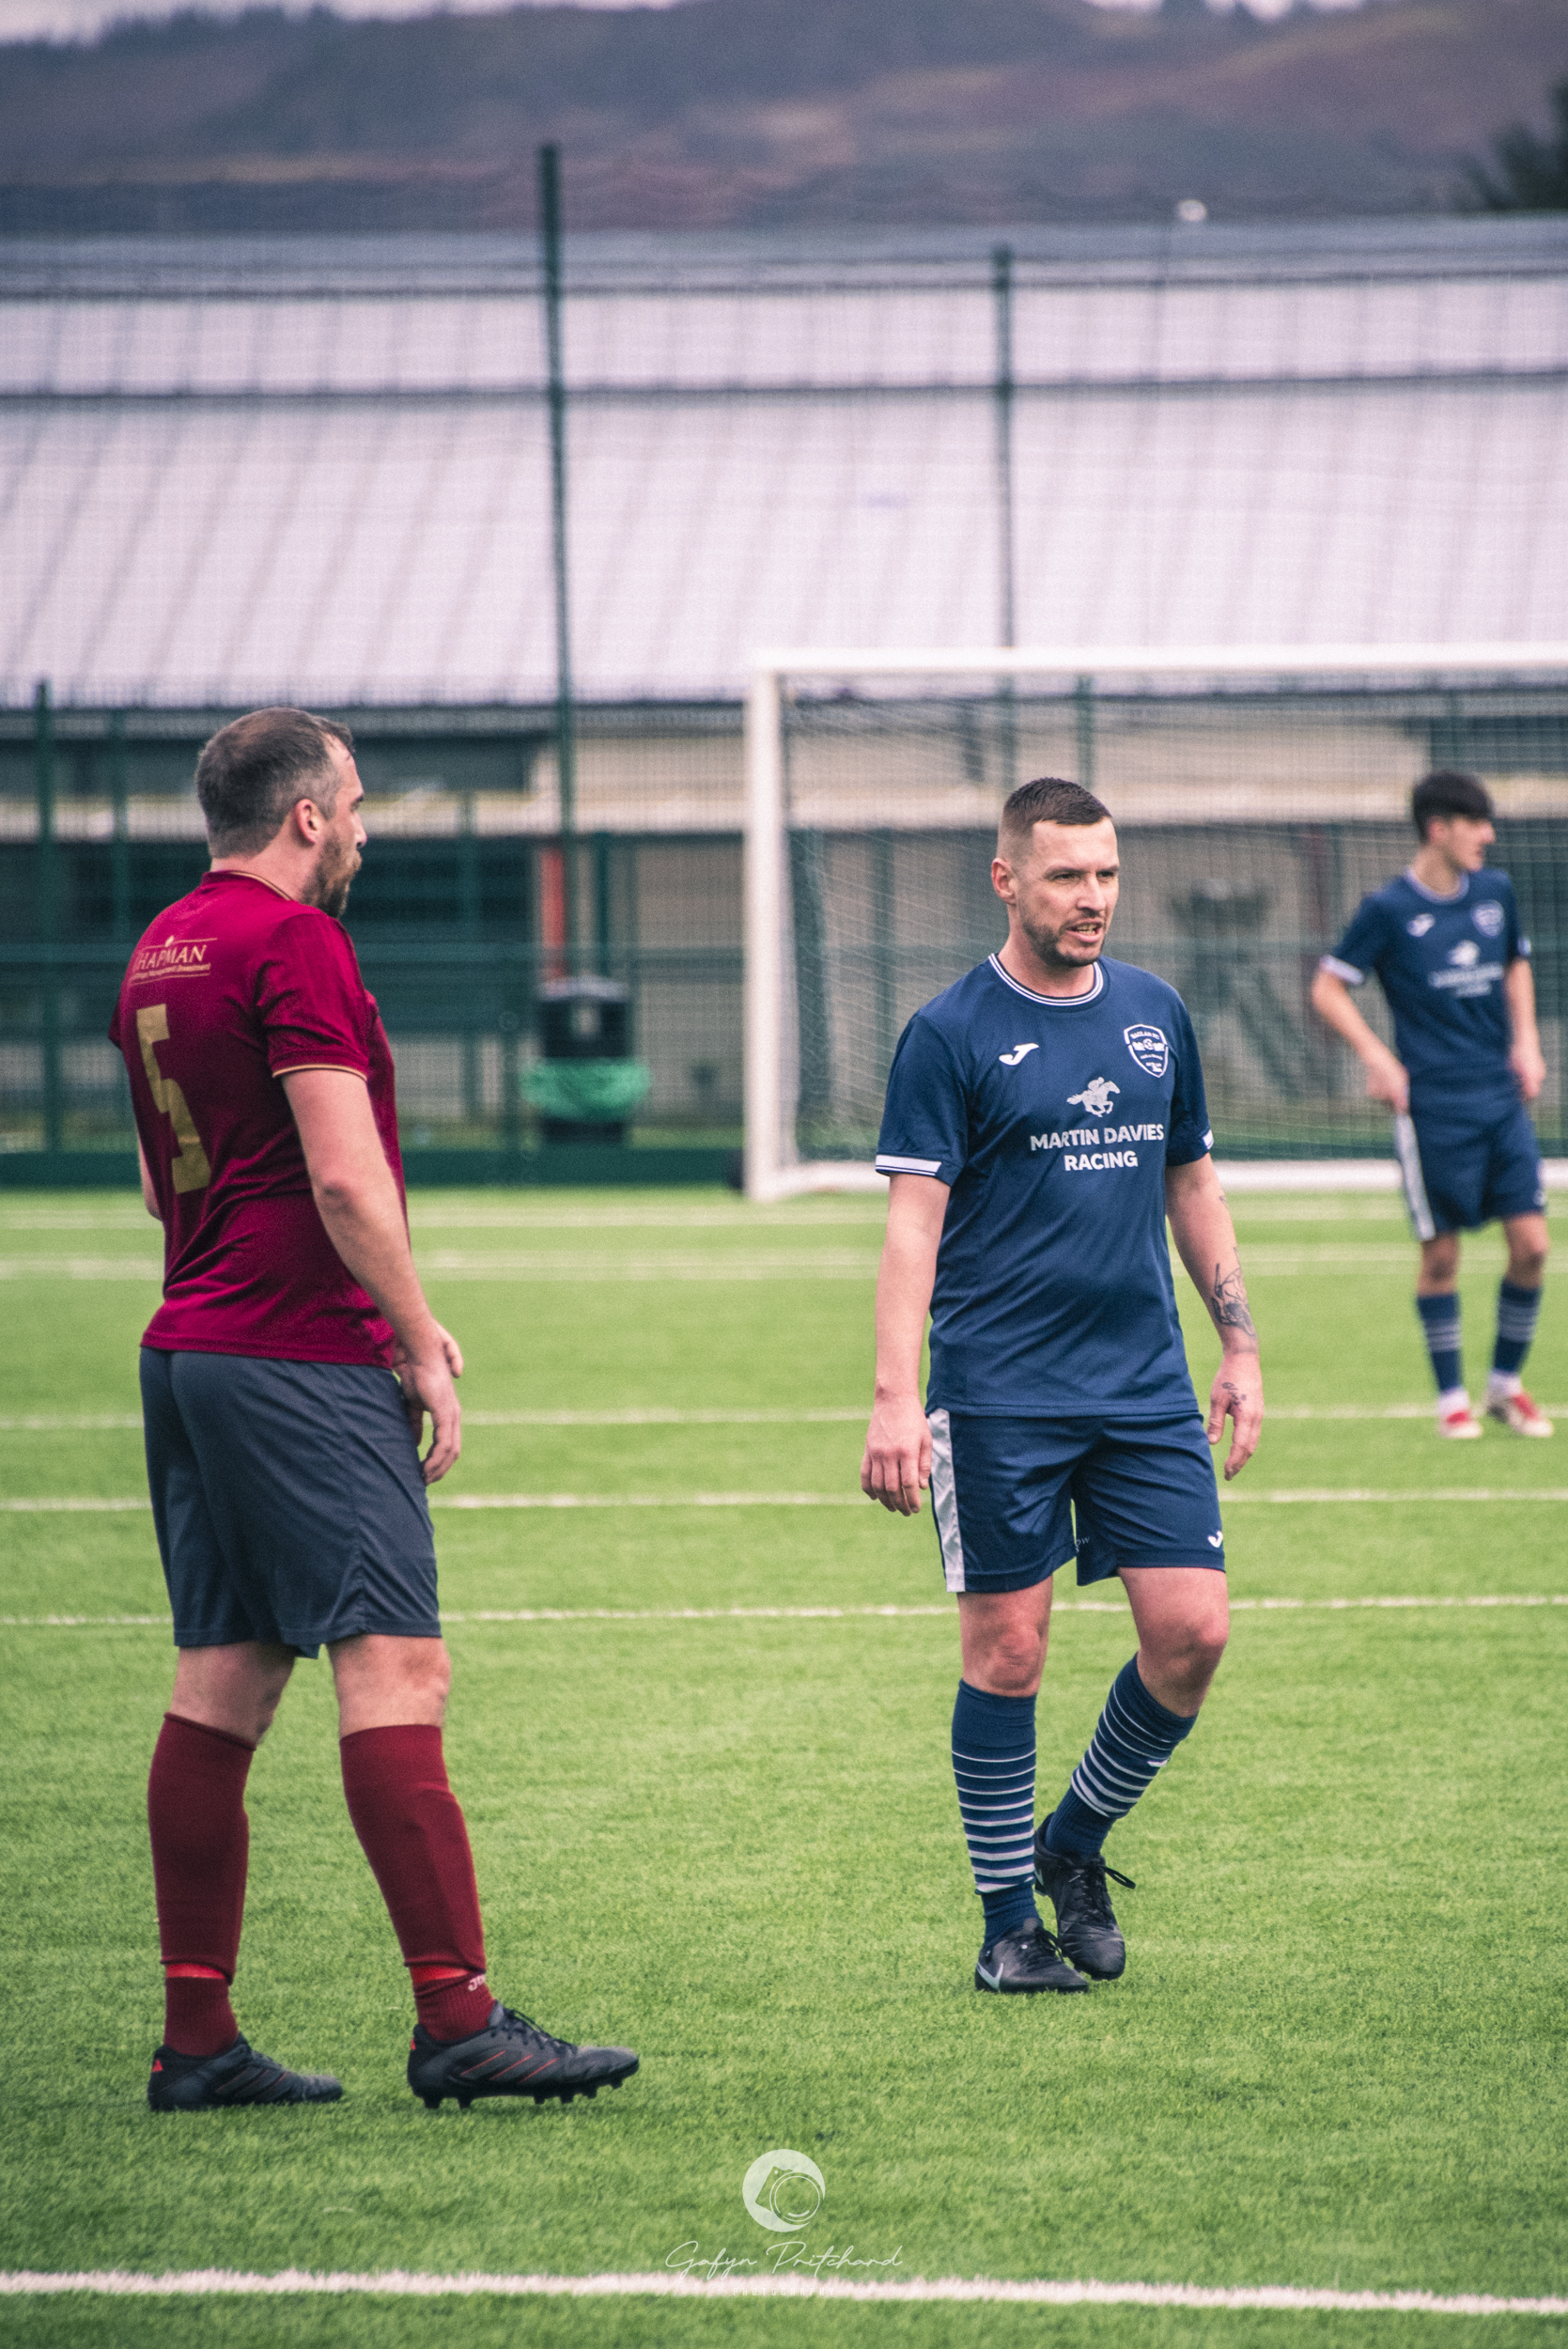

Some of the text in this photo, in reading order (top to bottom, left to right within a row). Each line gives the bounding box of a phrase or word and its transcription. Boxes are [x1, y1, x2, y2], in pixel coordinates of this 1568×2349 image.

[136, 1003, 211, 1194] 5
[1030, 1123, 1165, 1151] MARTIN DAVIES
[1063, 1150, 1139, 1172] RACING
